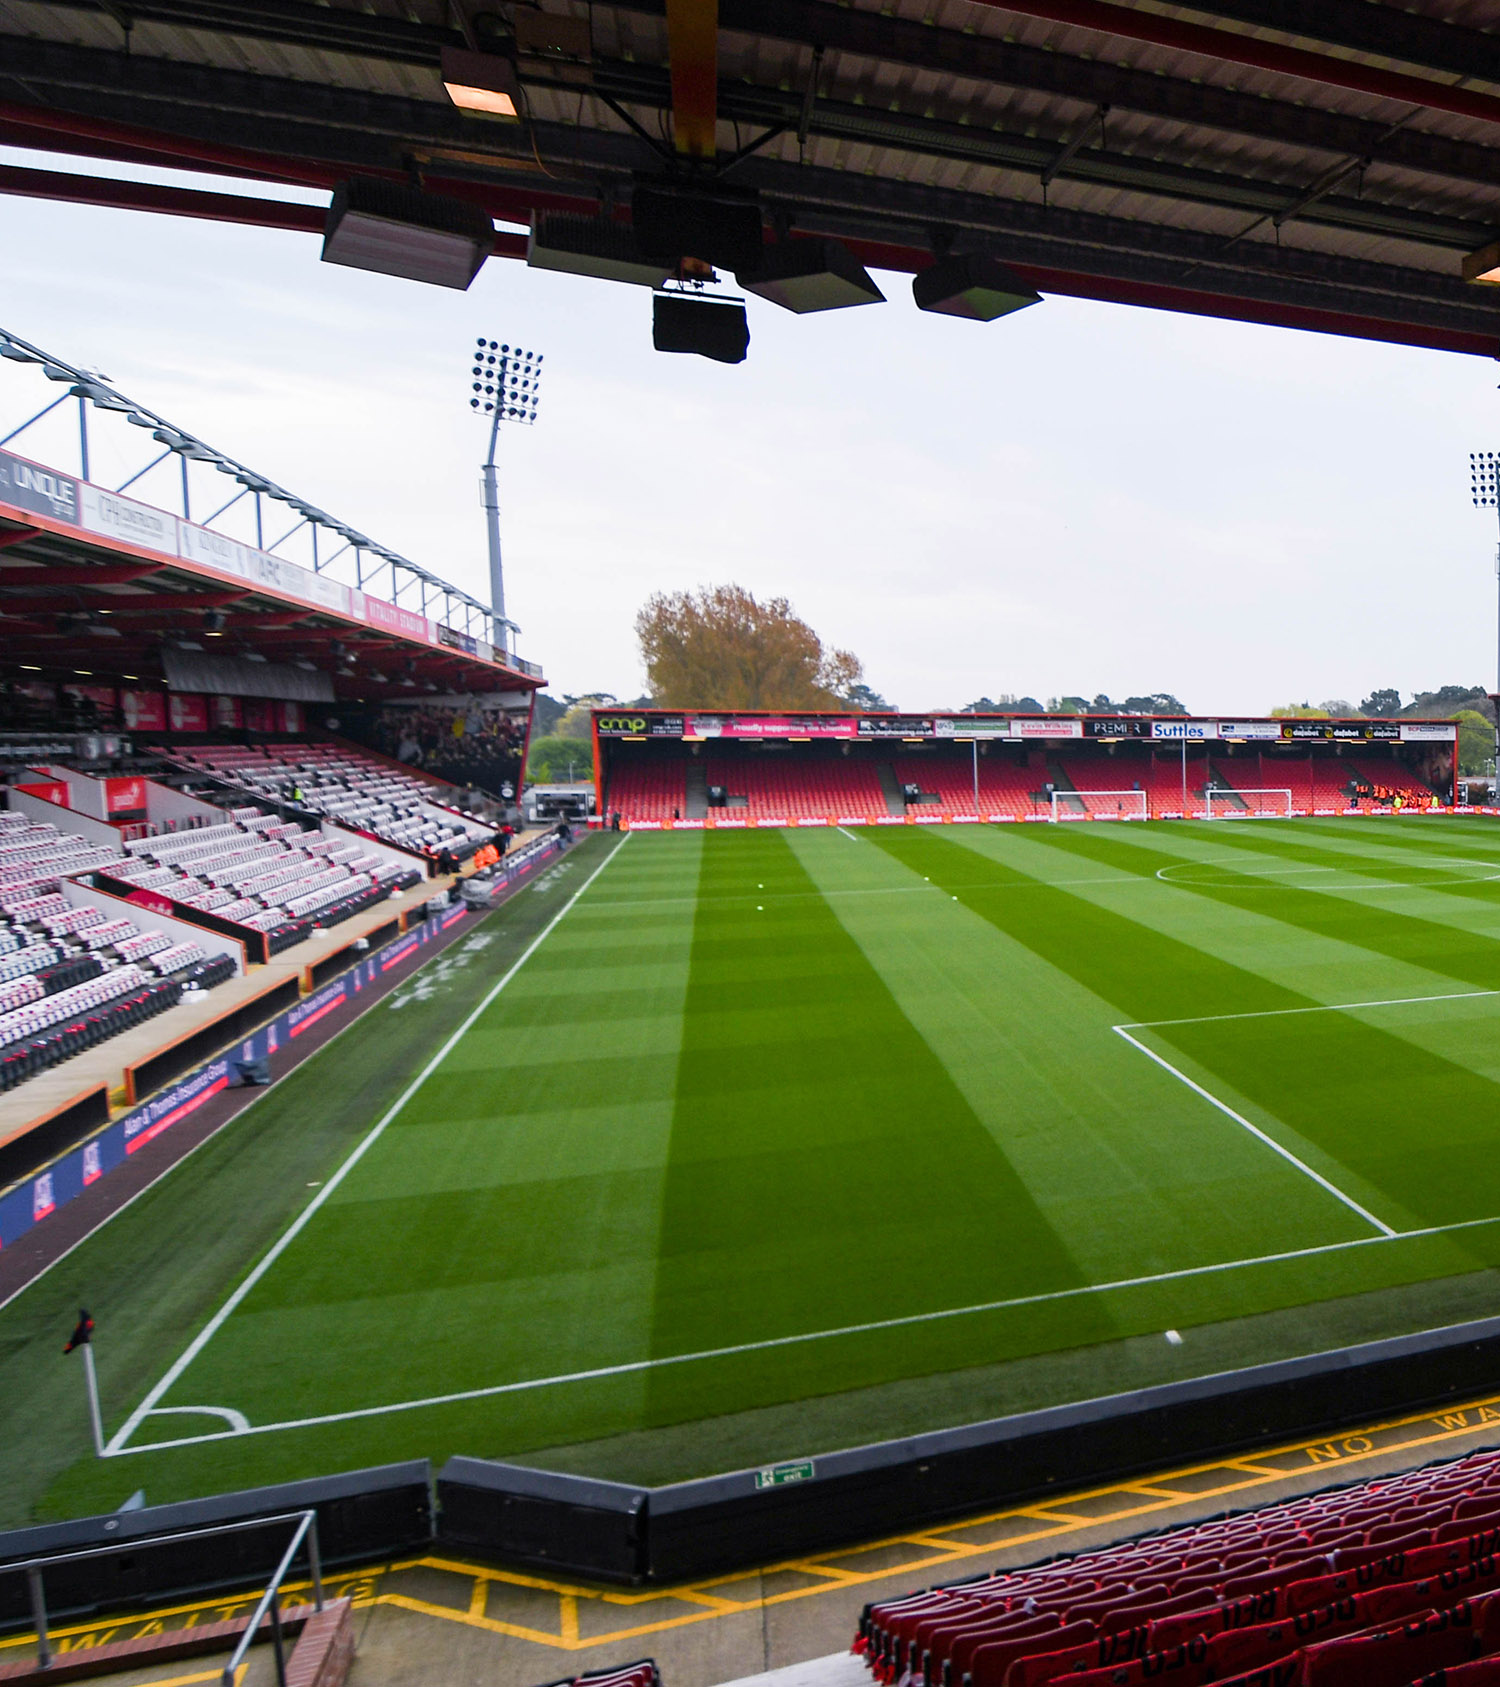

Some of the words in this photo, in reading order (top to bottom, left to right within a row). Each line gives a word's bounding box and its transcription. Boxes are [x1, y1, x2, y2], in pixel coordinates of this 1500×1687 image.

[599, 718, 645, 733] cmp
[1094, 723, 1141, 733] PREMIER
[1154, 724, 1204, 737] Suttles
[1306, 1436, 1374, 1463] NO
